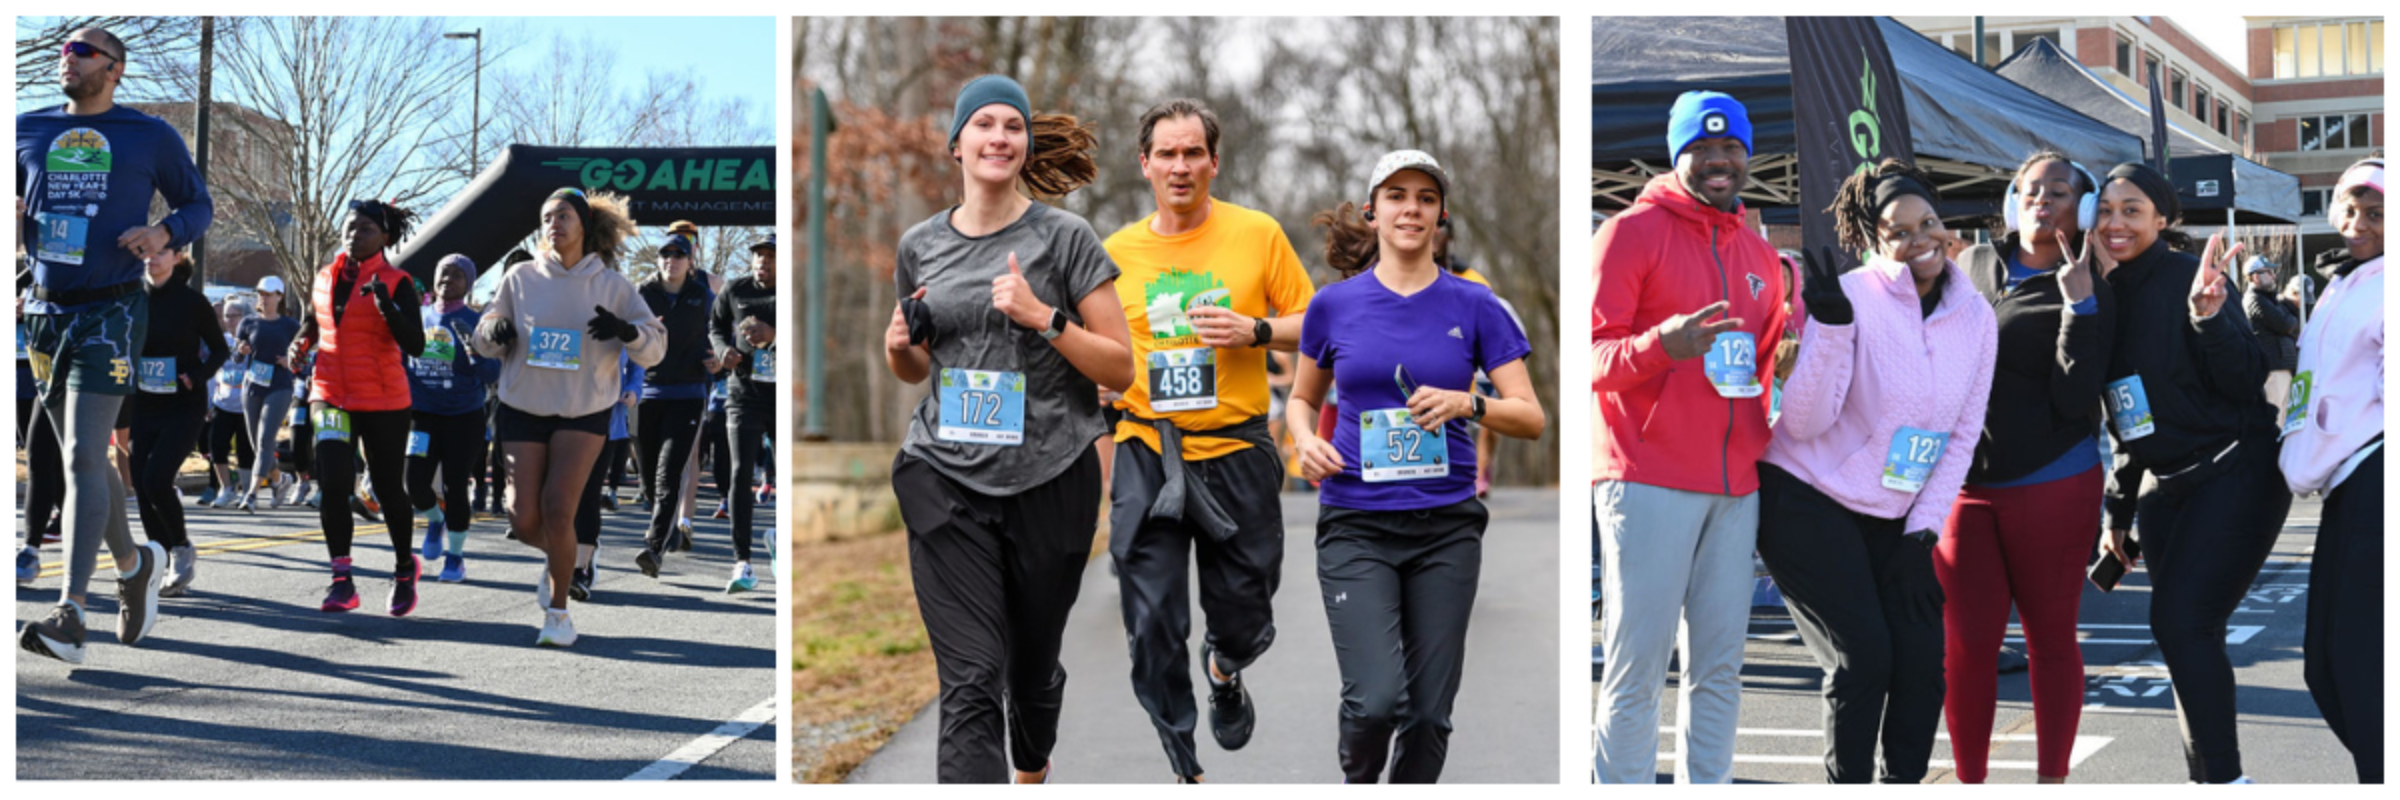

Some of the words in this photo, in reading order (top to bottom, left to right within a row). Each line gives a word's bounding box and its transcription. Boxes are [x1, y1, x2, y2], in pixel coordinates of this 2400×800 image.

[47, 173, 108, 181] CHARLOTTE
[47, 182, 71, 190] NEW
[47, 191, 67, 199] DAY
[67, 191, 81, 199] 5K
[50, 219, 69, 239] 14
[539, 331, 571, 351] 372
[141, 360, 165, 377] 172
[1159, 366, 1203, 397] 458
[960, 390, 1003, 426] 172
[317, 411, 343, 429] 141
[1386, 428, 1423, 463] 52
